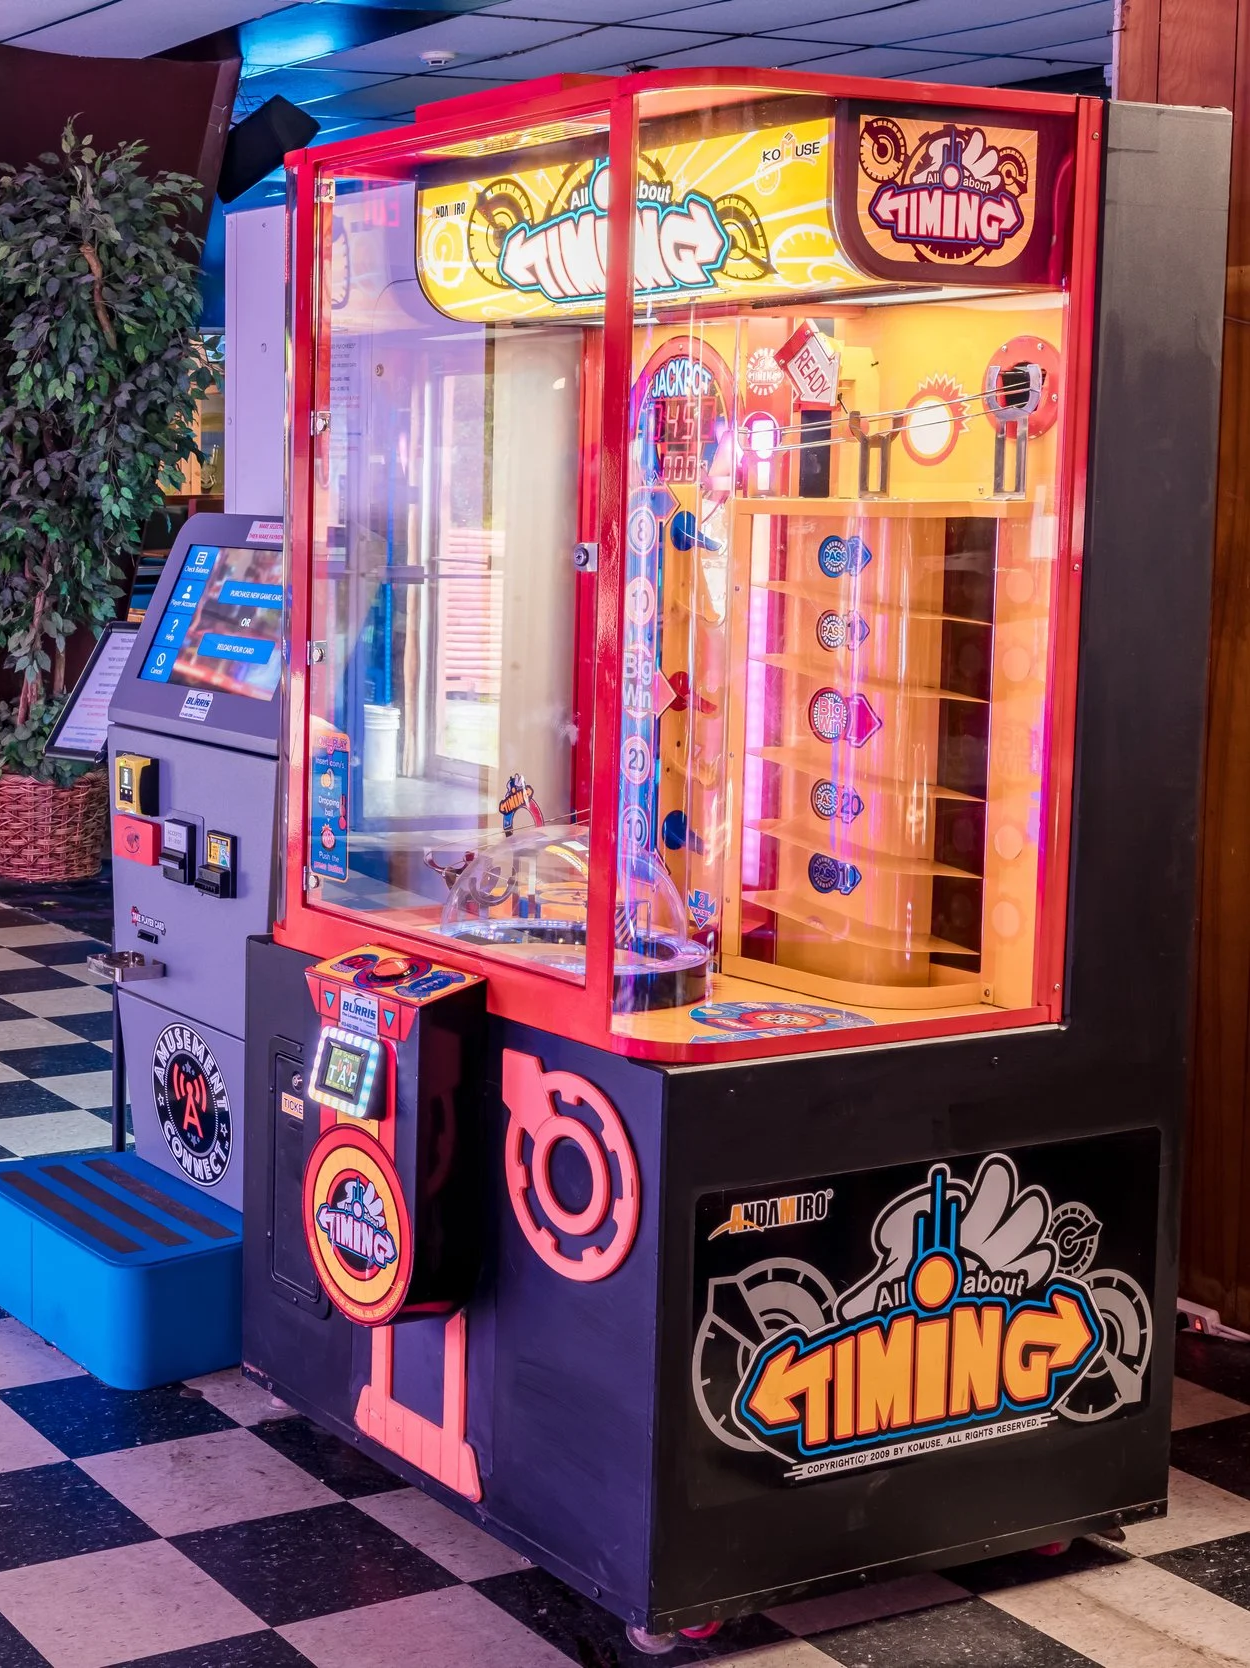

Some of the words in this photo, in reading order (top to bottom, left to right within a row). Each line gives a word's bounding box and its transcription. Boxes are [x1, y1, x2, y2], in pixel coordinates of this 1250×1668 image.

[762, 139, 820, 163] KOMUSE
[927, 171, 940, 184] All
[963, 171, 991, 193] about
[570, 189, 589, 210] All
[637, 182, 671, 204] bout
[874, 188, 1020, 241] TIMING
[652, 359, 713, 398] JACKPOT
[794, 348, 830, 399] READY
[824, 551, 847, 562] PASS
[182, 600, 197, 608] Account
[230, 590, 251, 598] PURCHASE
[240, 618, 251, 627] OR
[822, 625, 844, 637] PASS
[231, 645, 243, 653] YOUR
[242, 646, 254, 654] CARD
[150, 667, 163, 675] Cancel
[623, 682, 652, 708] Win
[818, 697, 843, 721] Big
[818, 714, 843, 734] Win
[629, 747, 645, 772] 20
[318, 795, 340, 809] Dropping
[816, 794, 838, 806] PASS
[841, 793, 861, 816] 20
[627, 816, 644, 840] 10
[319, 851, 330, 861] Push
[331, 853, 340, 863] the
[814, 867, 836, 879] PASS
[839, 865, 856, 887] 10
[698, 893, 705, 908] 2
[141, 915, 154, 927] PLAYER
[154, 920, 165, 931] CARD
[342, 1000, 377, 1020] BURRIS
[154, 1027, 229, 1113] AMUSEMENT
[330, 1063, 358, 1088] TAP
[163, 1119, 227, 1181] CONNECT
[317, 1206, 397, 1266] TIMING
[877, 1281, 906, 1312] All
[963, 1270, 1025, 1297] about
[748, 1293, 1093, 1447] TIMING
[870, 1450, 890, 1462] 2009
[893, 1446, 905, 1456] BY
[946, 1435, 962, 1445] ALL
[964, 1427, 994, 1441] RIGHTS
[996, 1418, 1040, 1434] RESERVED.
